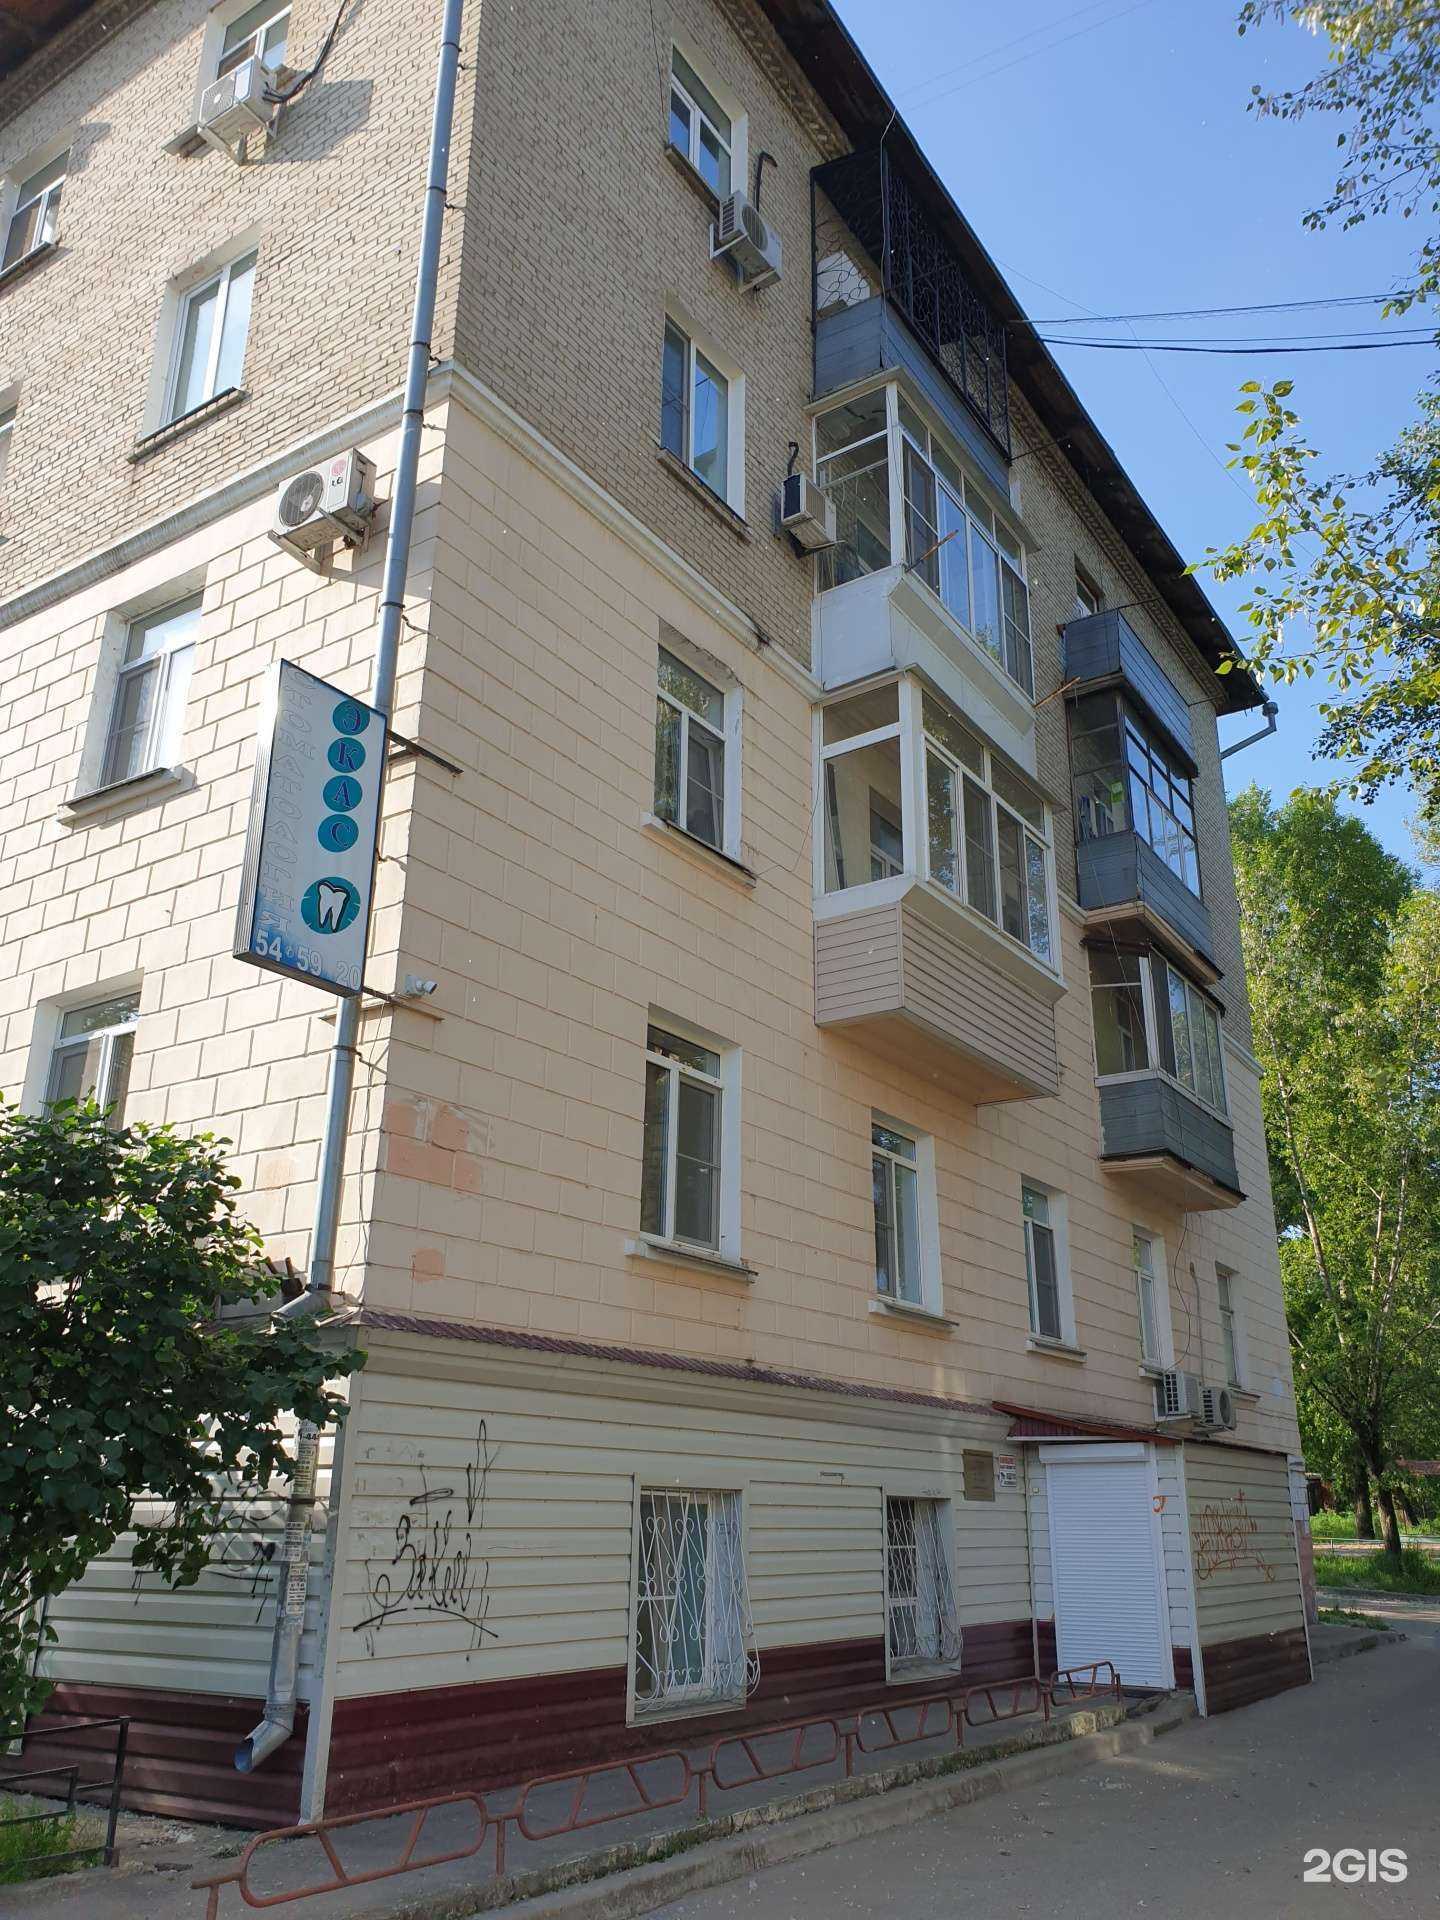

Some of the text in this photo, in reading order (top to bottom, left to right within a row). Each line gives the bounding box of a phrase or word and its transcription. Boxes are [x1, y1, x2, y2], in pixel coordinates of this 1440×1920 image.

[330, 702, 362, 850] ЭКАС
[255, 930, 361, 991] 54 59 20
